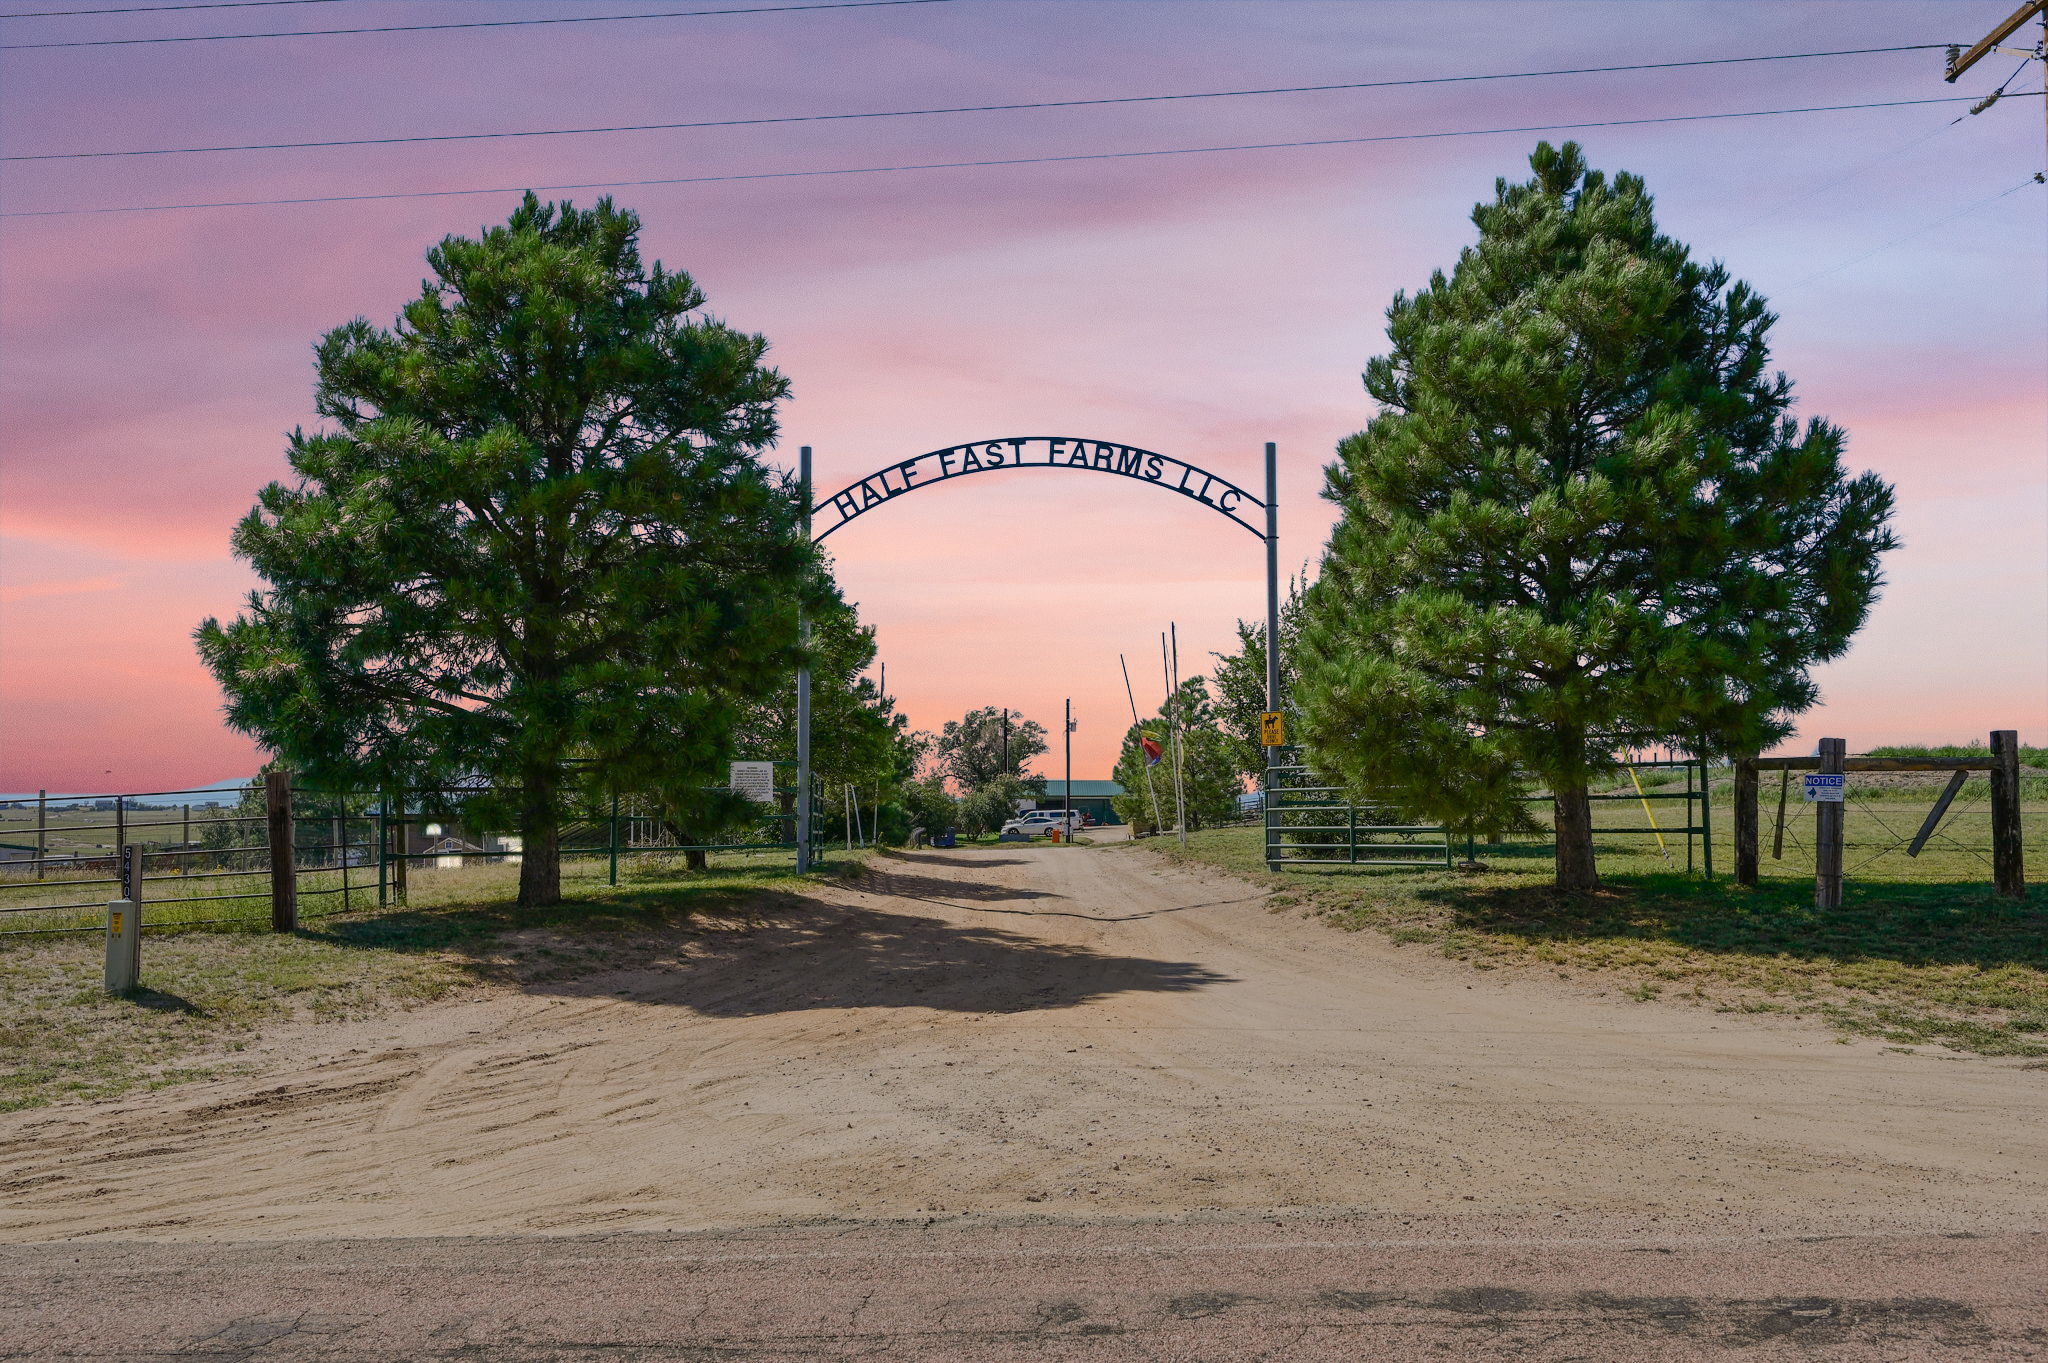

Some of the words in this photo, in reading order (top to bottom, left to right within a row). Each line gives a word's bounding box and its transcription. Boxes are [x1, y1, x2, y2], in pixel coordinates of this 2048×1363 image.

[833, 461, 917, 520] HALF
[938, 438, 1026, 477] FAST
[1050, 438, 1164, 482] FARMS
[1179, 465, 1241, 513] LLC
[1805, 777, 1842, 785] NOTICE
